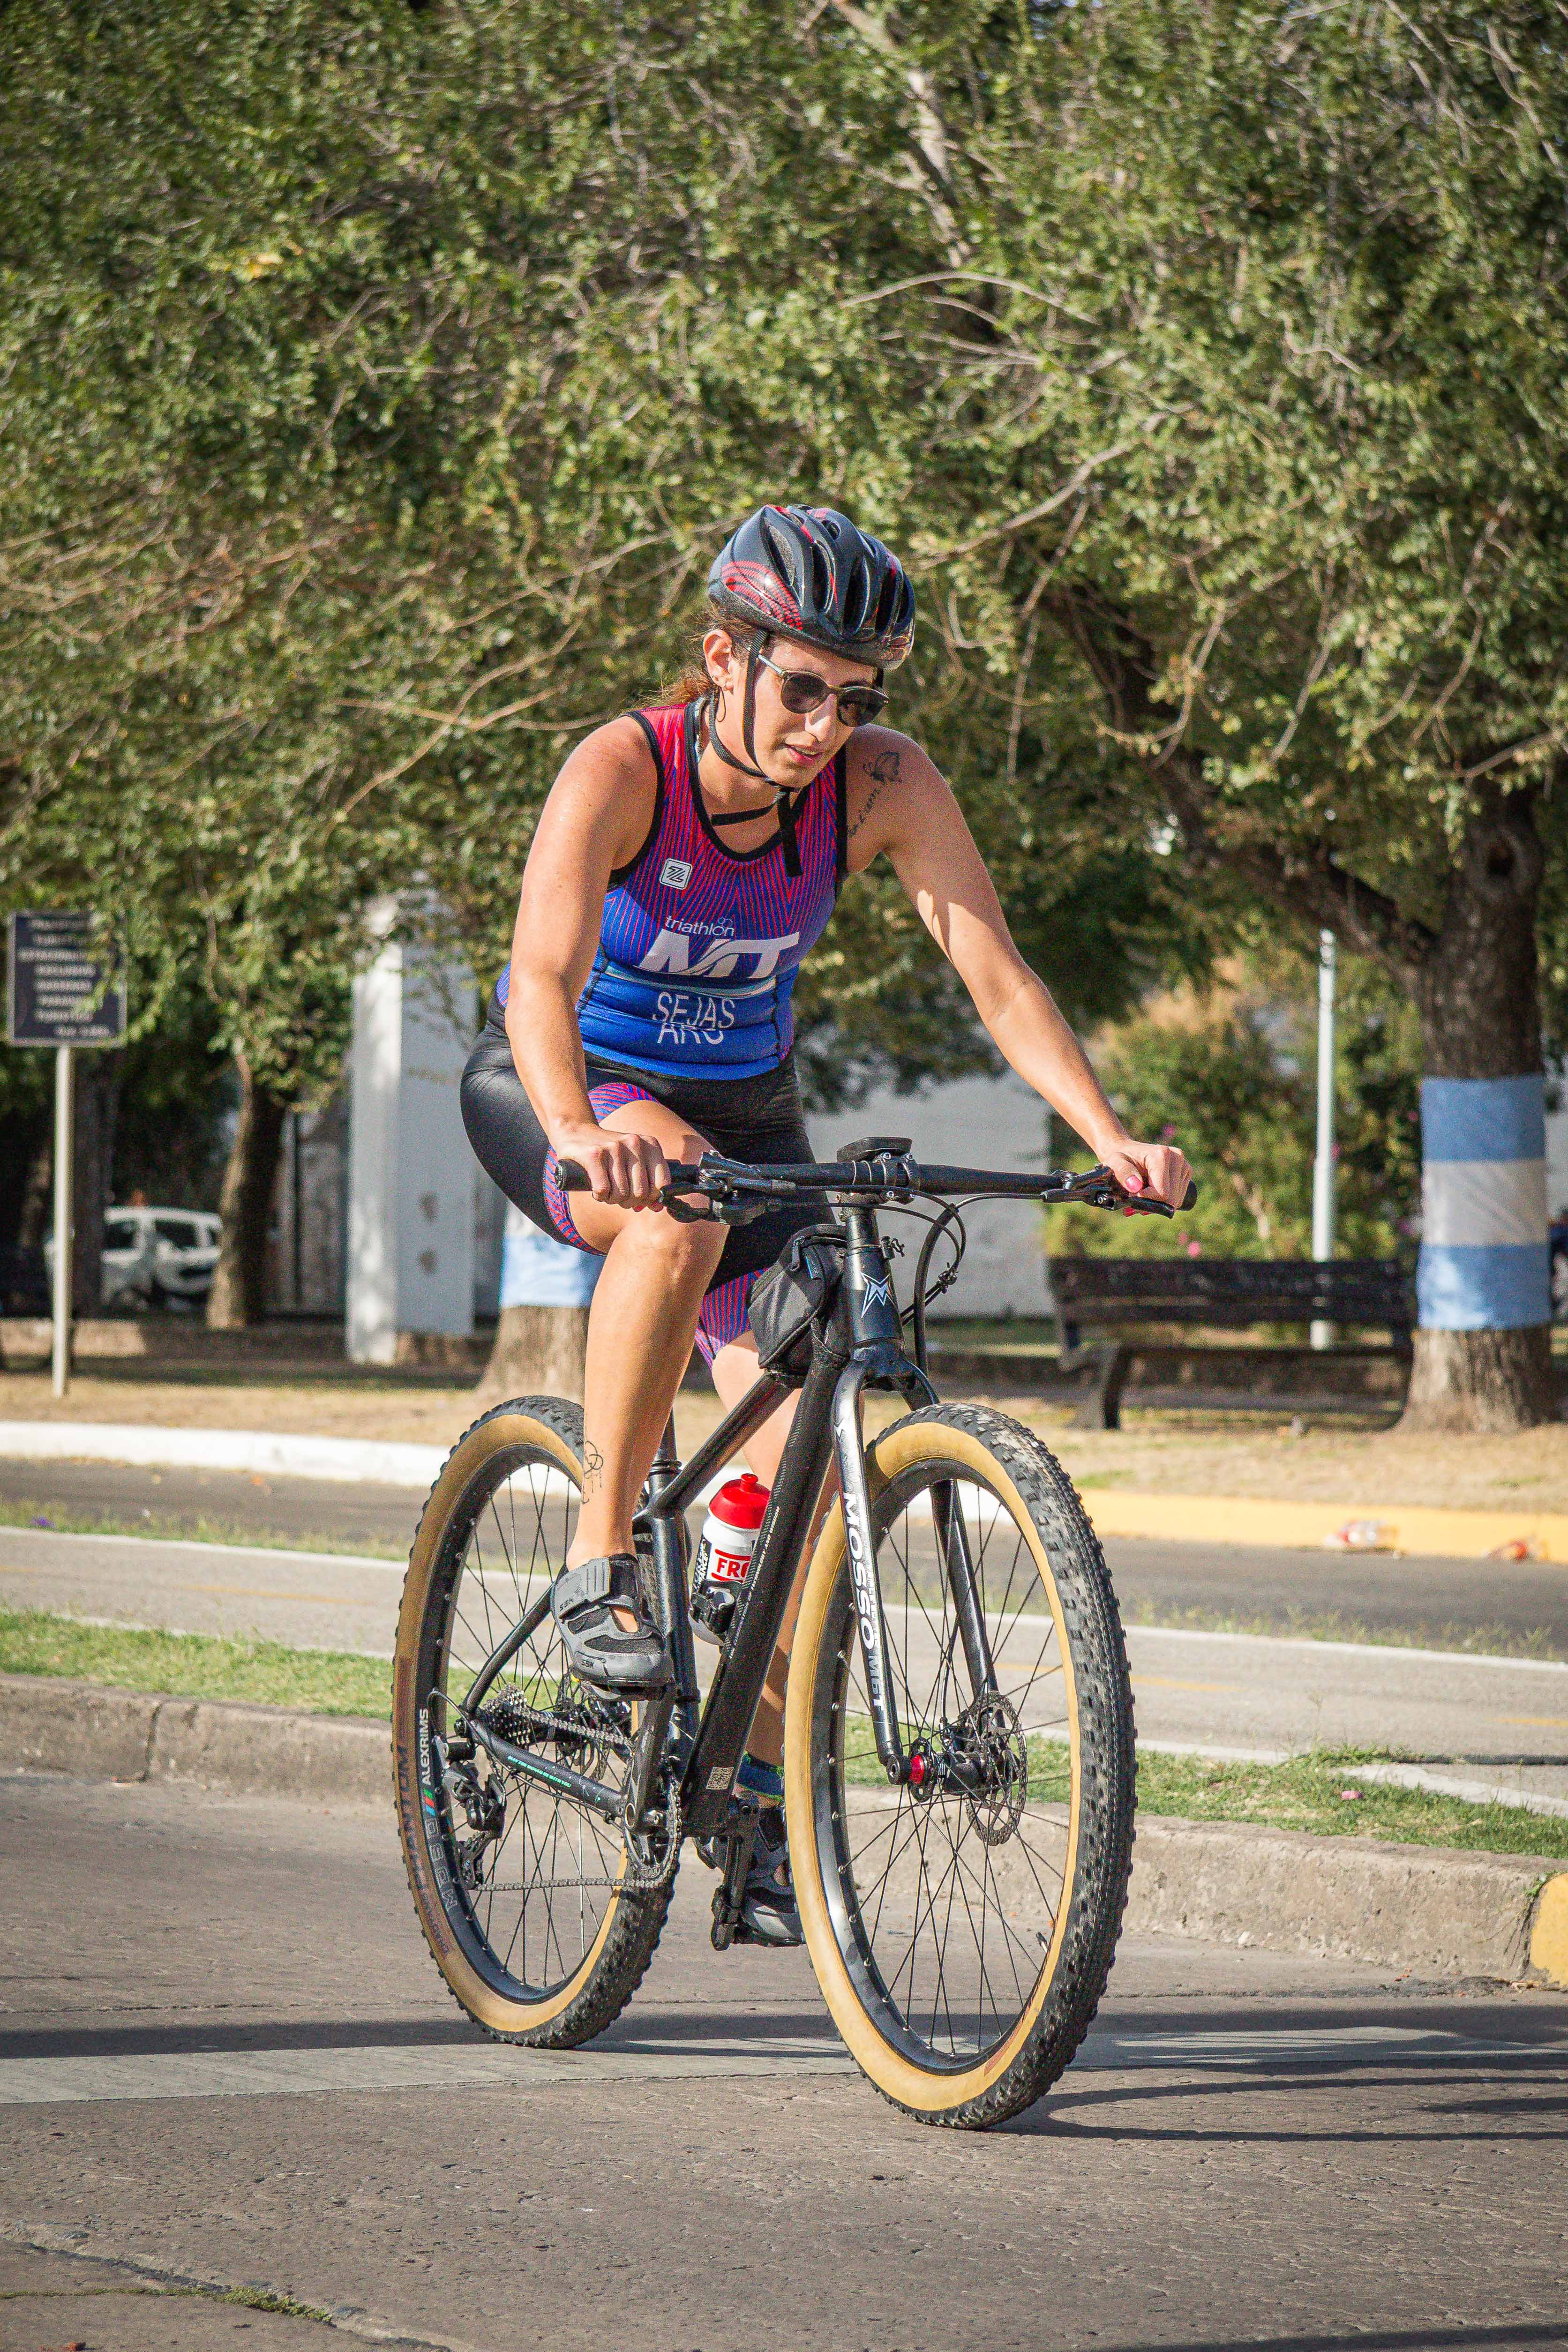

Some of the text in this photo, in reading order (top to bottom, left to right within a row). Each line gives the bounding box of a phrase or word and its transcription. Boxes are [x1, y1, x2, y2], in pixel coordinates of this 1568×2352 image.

[665, 915, 735, 936] triathlon
[652, 992, 735, 1030] SEJAS
[844, 1492, 875, 1650] MOSSO
[420, 1708, 431, 1785] ALEXRIMS
